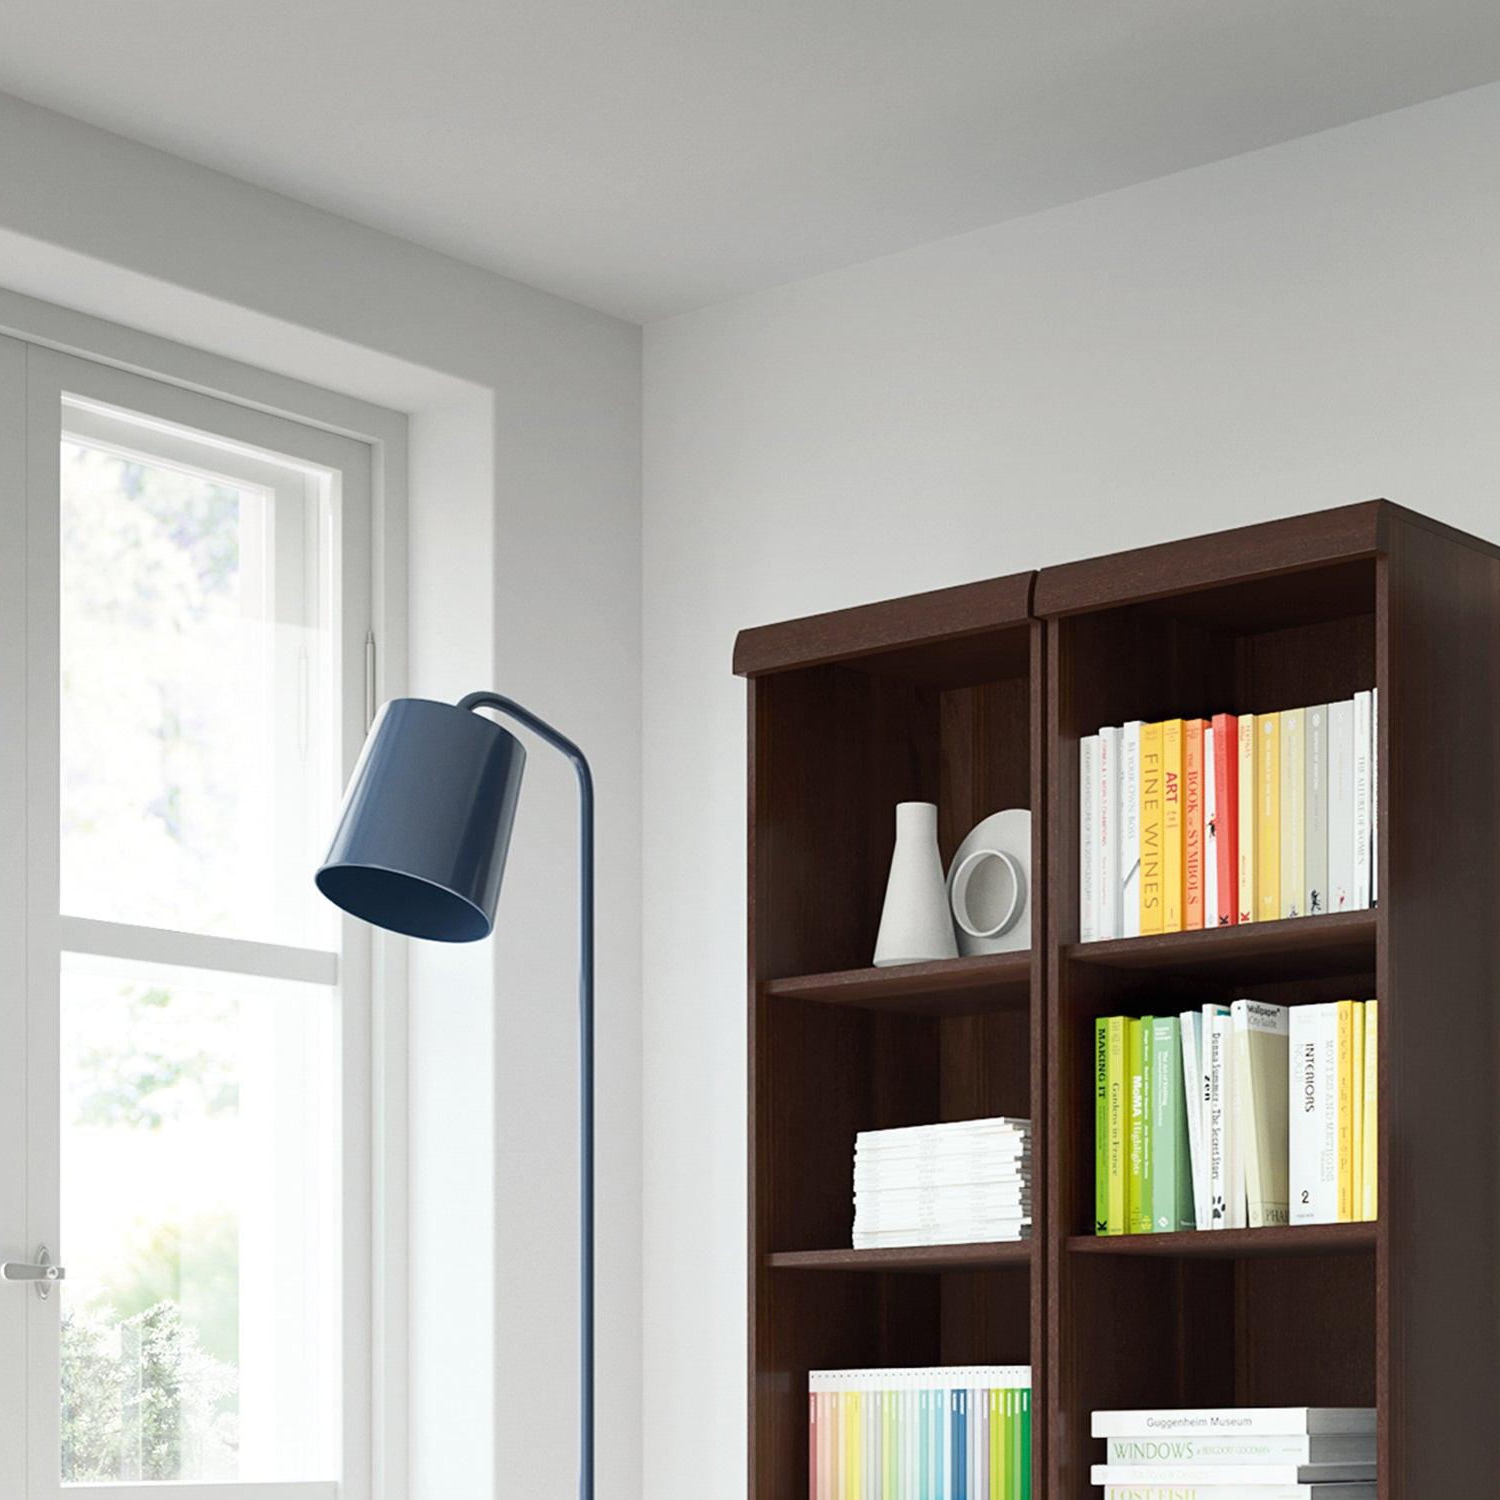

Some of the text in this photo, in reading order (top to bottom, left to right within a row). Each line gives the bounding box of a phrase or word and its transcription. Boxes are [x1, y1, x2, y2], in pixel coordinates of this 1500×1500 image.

[1144, 753, 1159, 811] FINE
[1166, 772, 1178, 804] ART
[1188, 771, 1199, 814] BOOK
[1144, 823, 1159, 910] WINES
[1188, 830, 1199, 905] SYMBOLS
[1098, 1028, 1107, 1082] MAKING
[1212, 1032, 1221, 1062] Donna
[1098, 1086, 1107, 1099] IT
[1212, 1064, 1221, 1102] Summer
[1305, 1043, 1315, 1113] INTERIORS
[1112, 1082, 1120, 1176] Gardens in France
[1130, 1075, 1142, 1175] MoMA Highlights
[1212, 1109, 1221, 1126] The
[1212, 1128, 1221, 1156] Secret
[1212, 1157, 1221, 1180] Story
[1301, 1190, 1310, 1204] 2
[1146, 1416, 1253, 1429] Guggenheim Museum
[1113, 1442, 1194, 1460] WINDOWS
